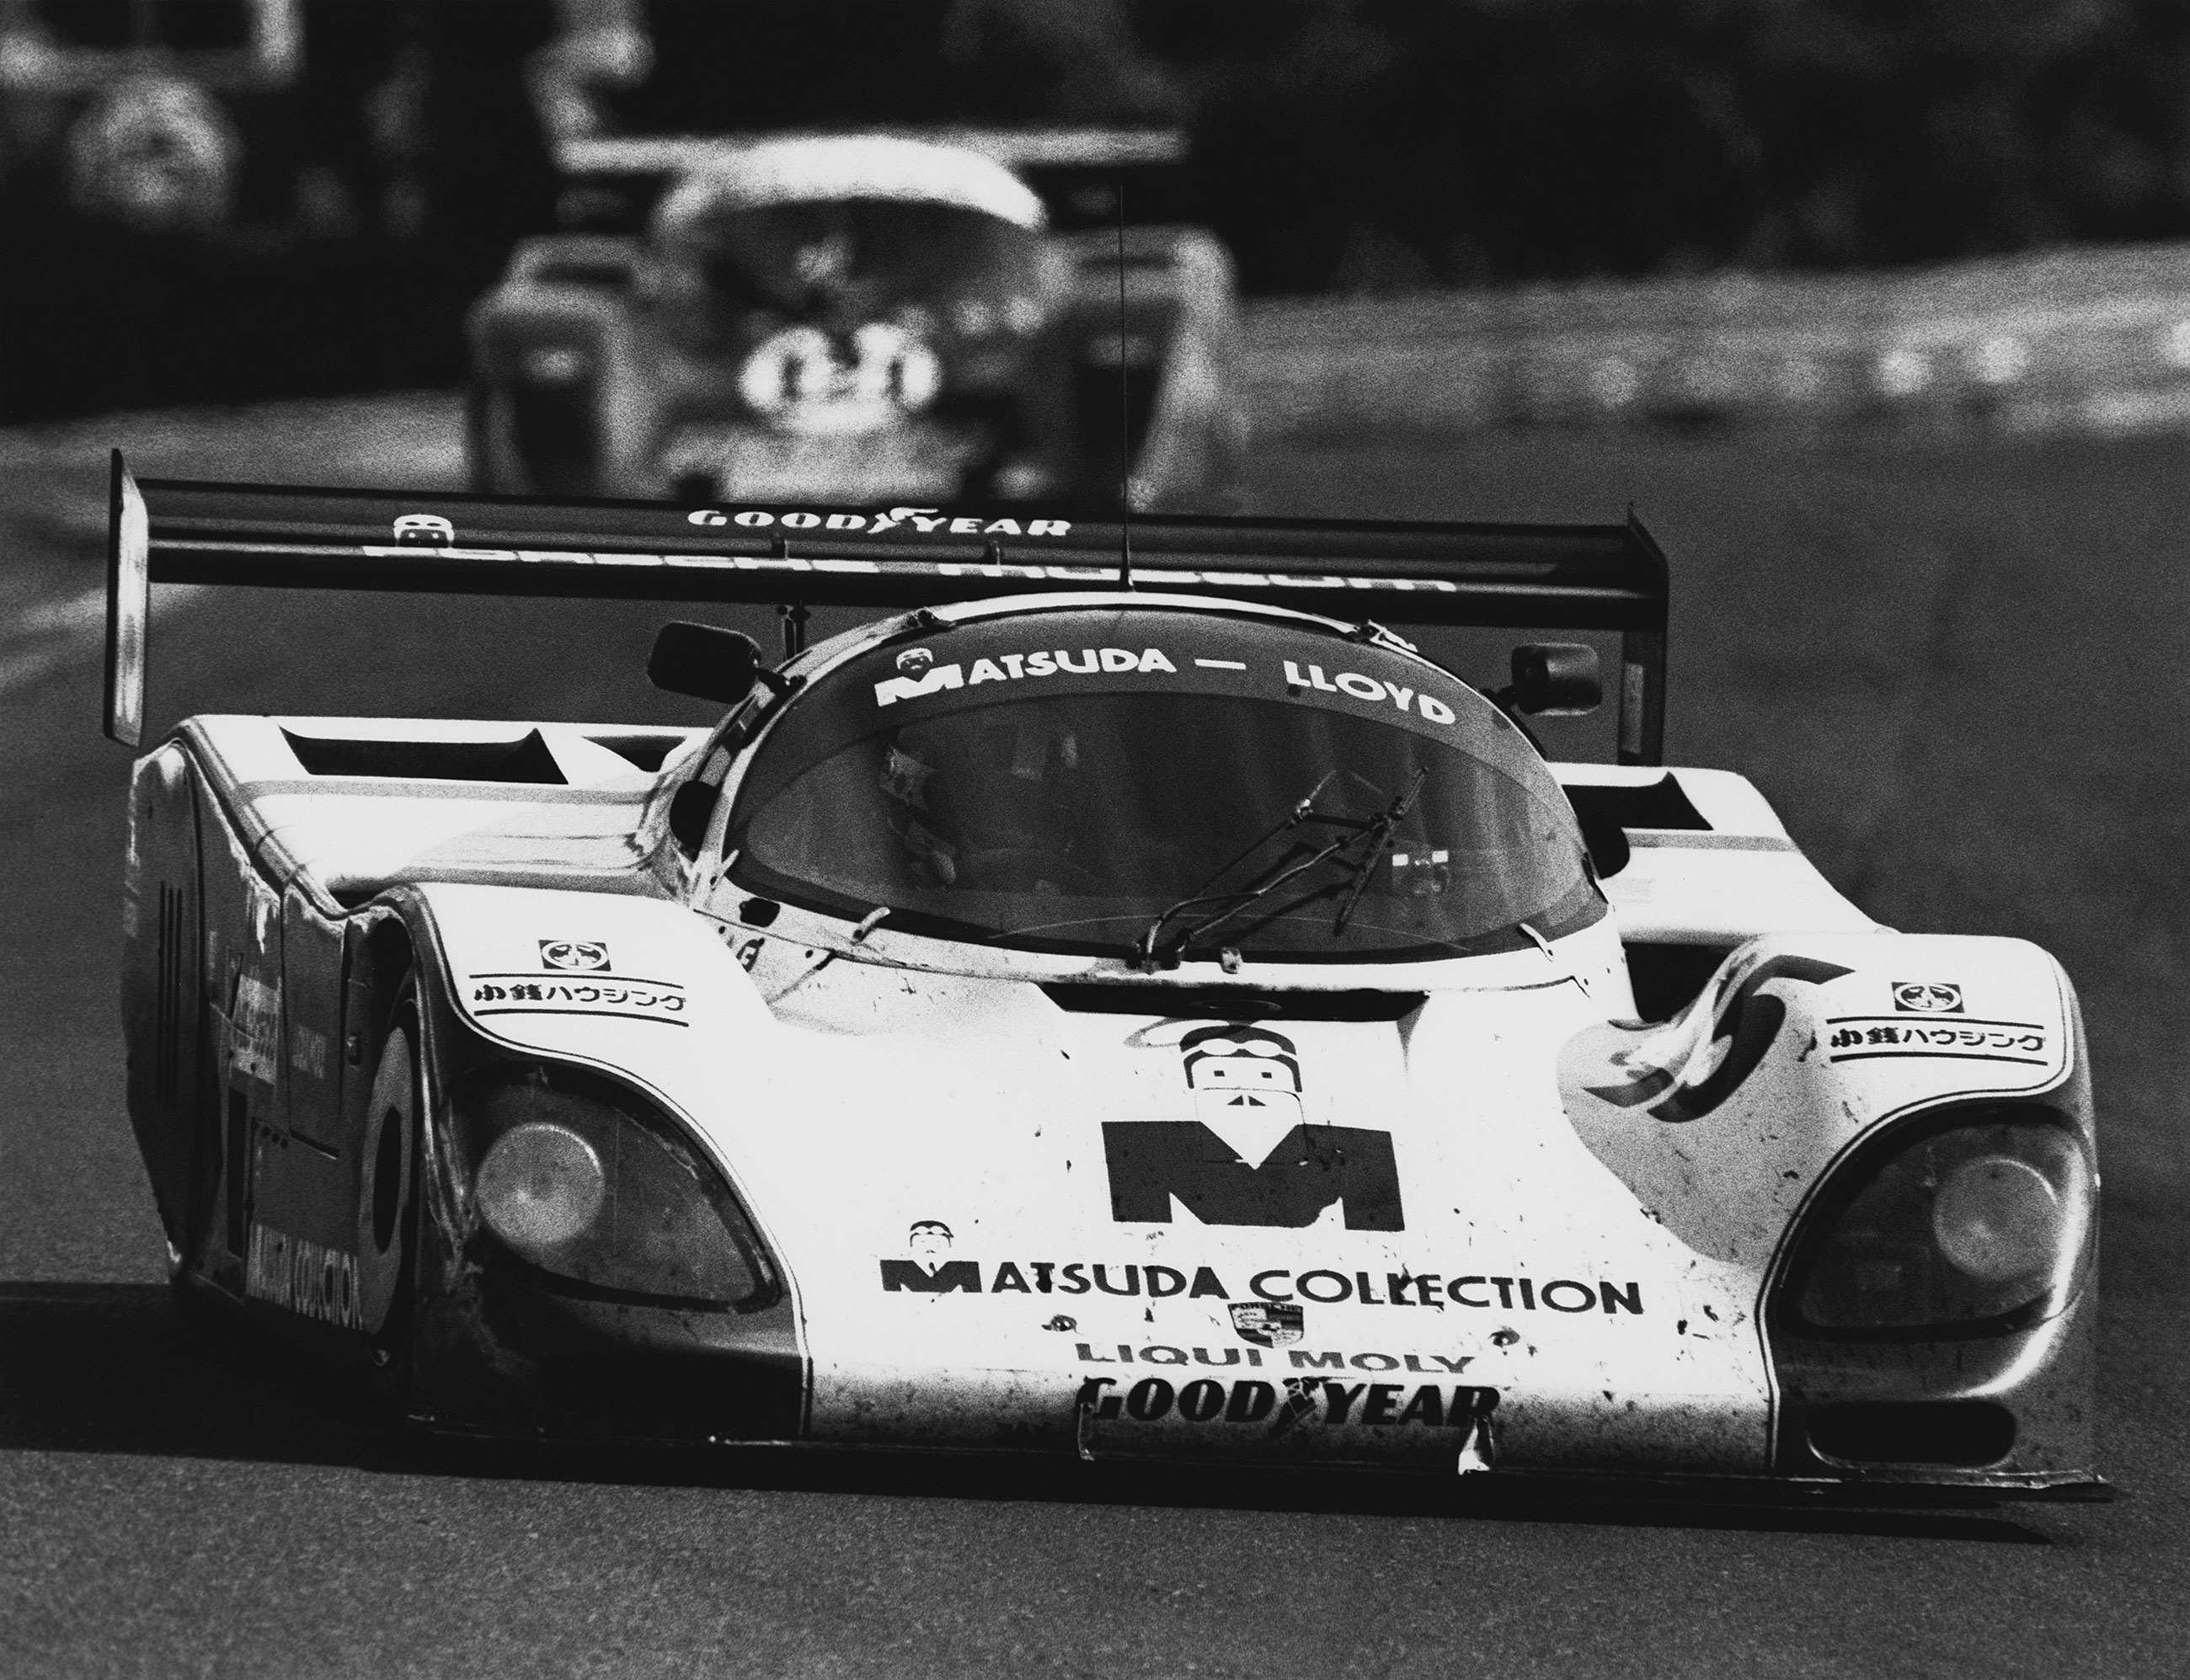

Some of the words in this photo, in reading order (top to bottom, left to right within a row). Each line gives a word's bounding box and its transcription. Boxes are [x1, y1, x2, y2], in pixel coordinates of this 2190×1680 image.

[688, 508, 1072, 536] GOODYEAR
[875, 648, 1178, 707] MATSUDA
[1283, 660, 1457, 725] LLOYD
[879, 1259, 1231, 1300] MATSUDA
[1249, 1269, 1644, 1315] COLLECTION
[1075, 1342, 1263, 1367] LIQUI
[1288, 1350, 1475, 1374] MOLY
[1076, 1375, 1502, 1427] GOODYEAR
